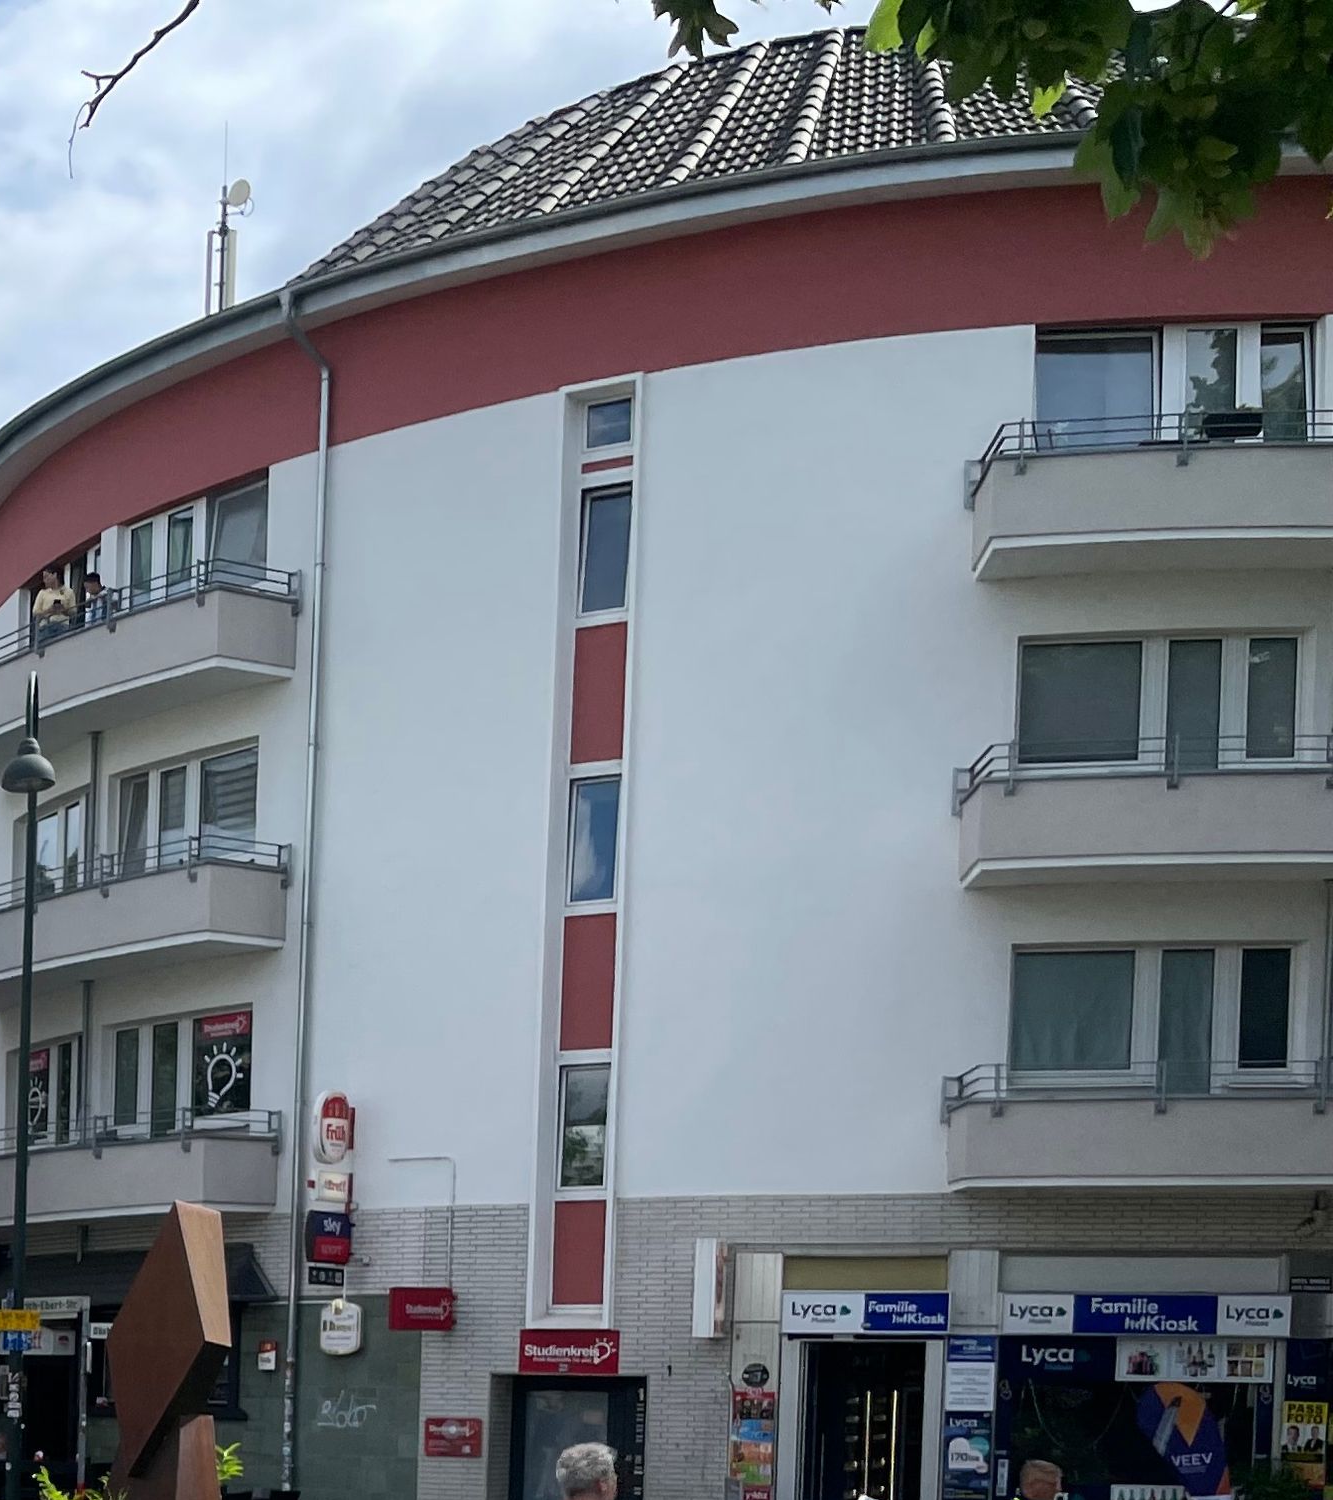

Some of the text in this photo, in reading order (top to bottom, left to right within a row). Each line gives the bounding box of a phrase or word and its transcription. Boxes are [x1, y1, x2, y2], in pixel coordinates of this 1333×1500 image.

[323, 1218, 342, 1236] sky
[791, 1301, 837, 1318] Lyca
[868, 1300, 918, 1313] Familie
[1091, 1297, 1159, 1314] Familie
[1009, 1304, 1054, 1324] Lyca
[1225, 1304, 1270, 1324] Lyca
[524, 1344, 599, 1357] Studienkreis
[1021, 1344, 1074, 1365] Lyca
[1287, 1373, 1317, 1387] Lyca
[1287, 1404, 1324, 1414] PASS
[949, 1418, 978, 1428] Lyca
[1287, 1413, 1324, 1424] FOTO
[1171, 1452, 1213, 1467] VEEV
